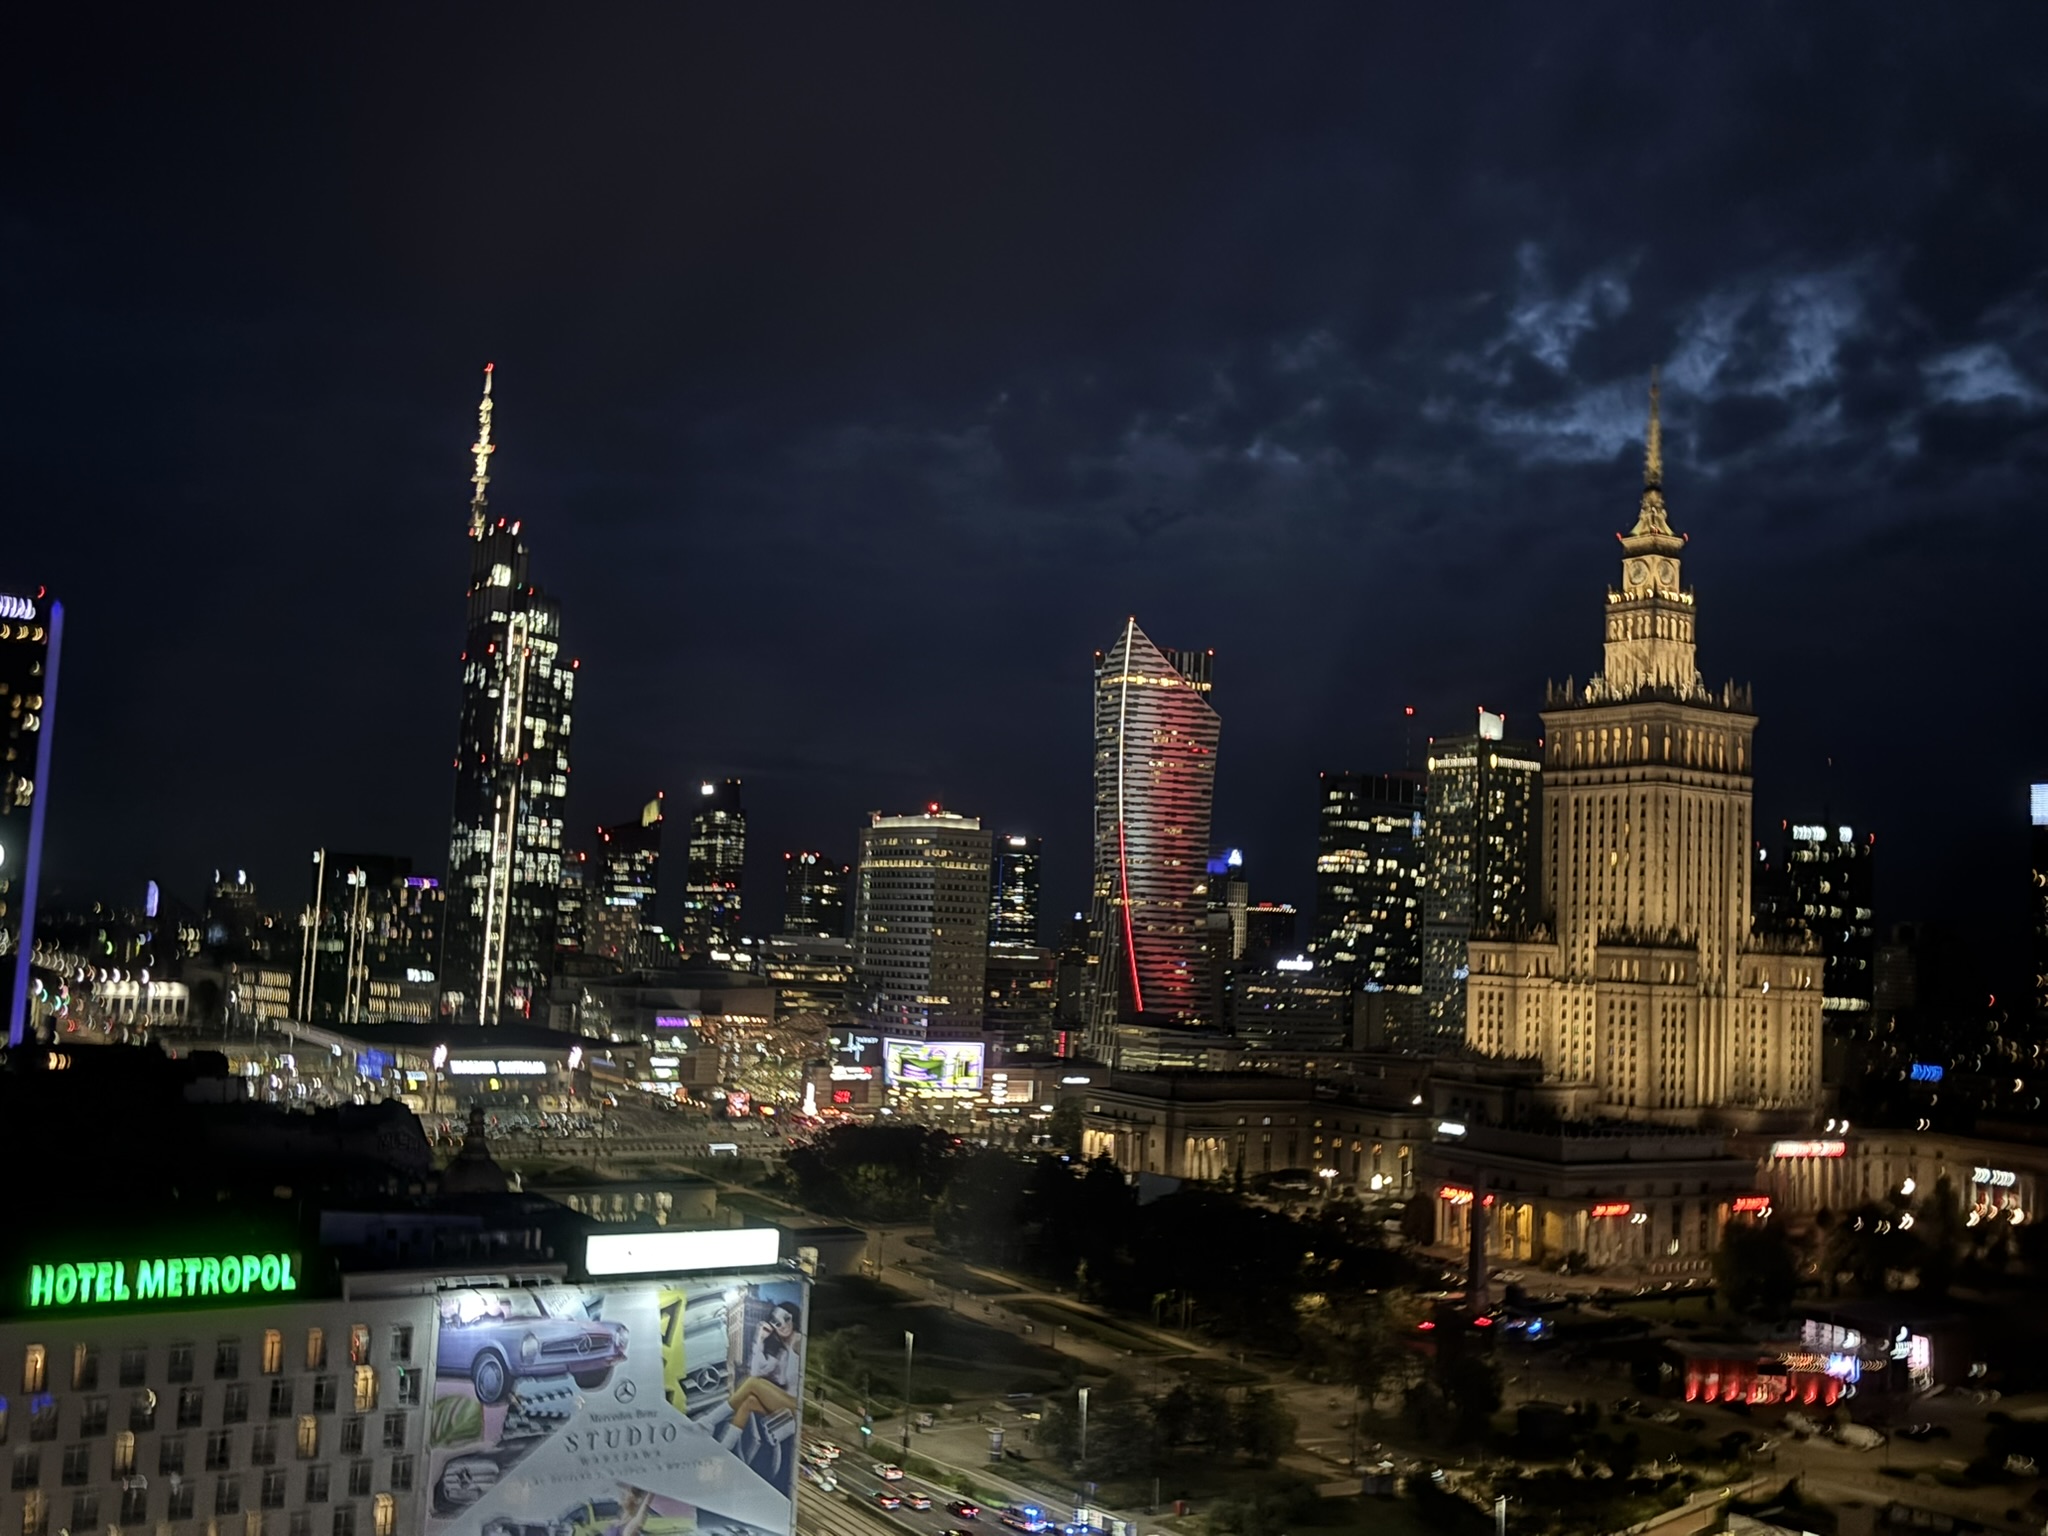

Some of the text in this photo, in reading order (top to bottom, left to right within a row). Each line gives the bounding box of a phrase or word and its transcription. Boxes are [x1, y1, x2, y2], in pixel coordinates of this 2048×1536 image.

[30, 1253, 297, 1307] HOTEL METROPOL
[565, 1423, 676, 1453] STUDIO
